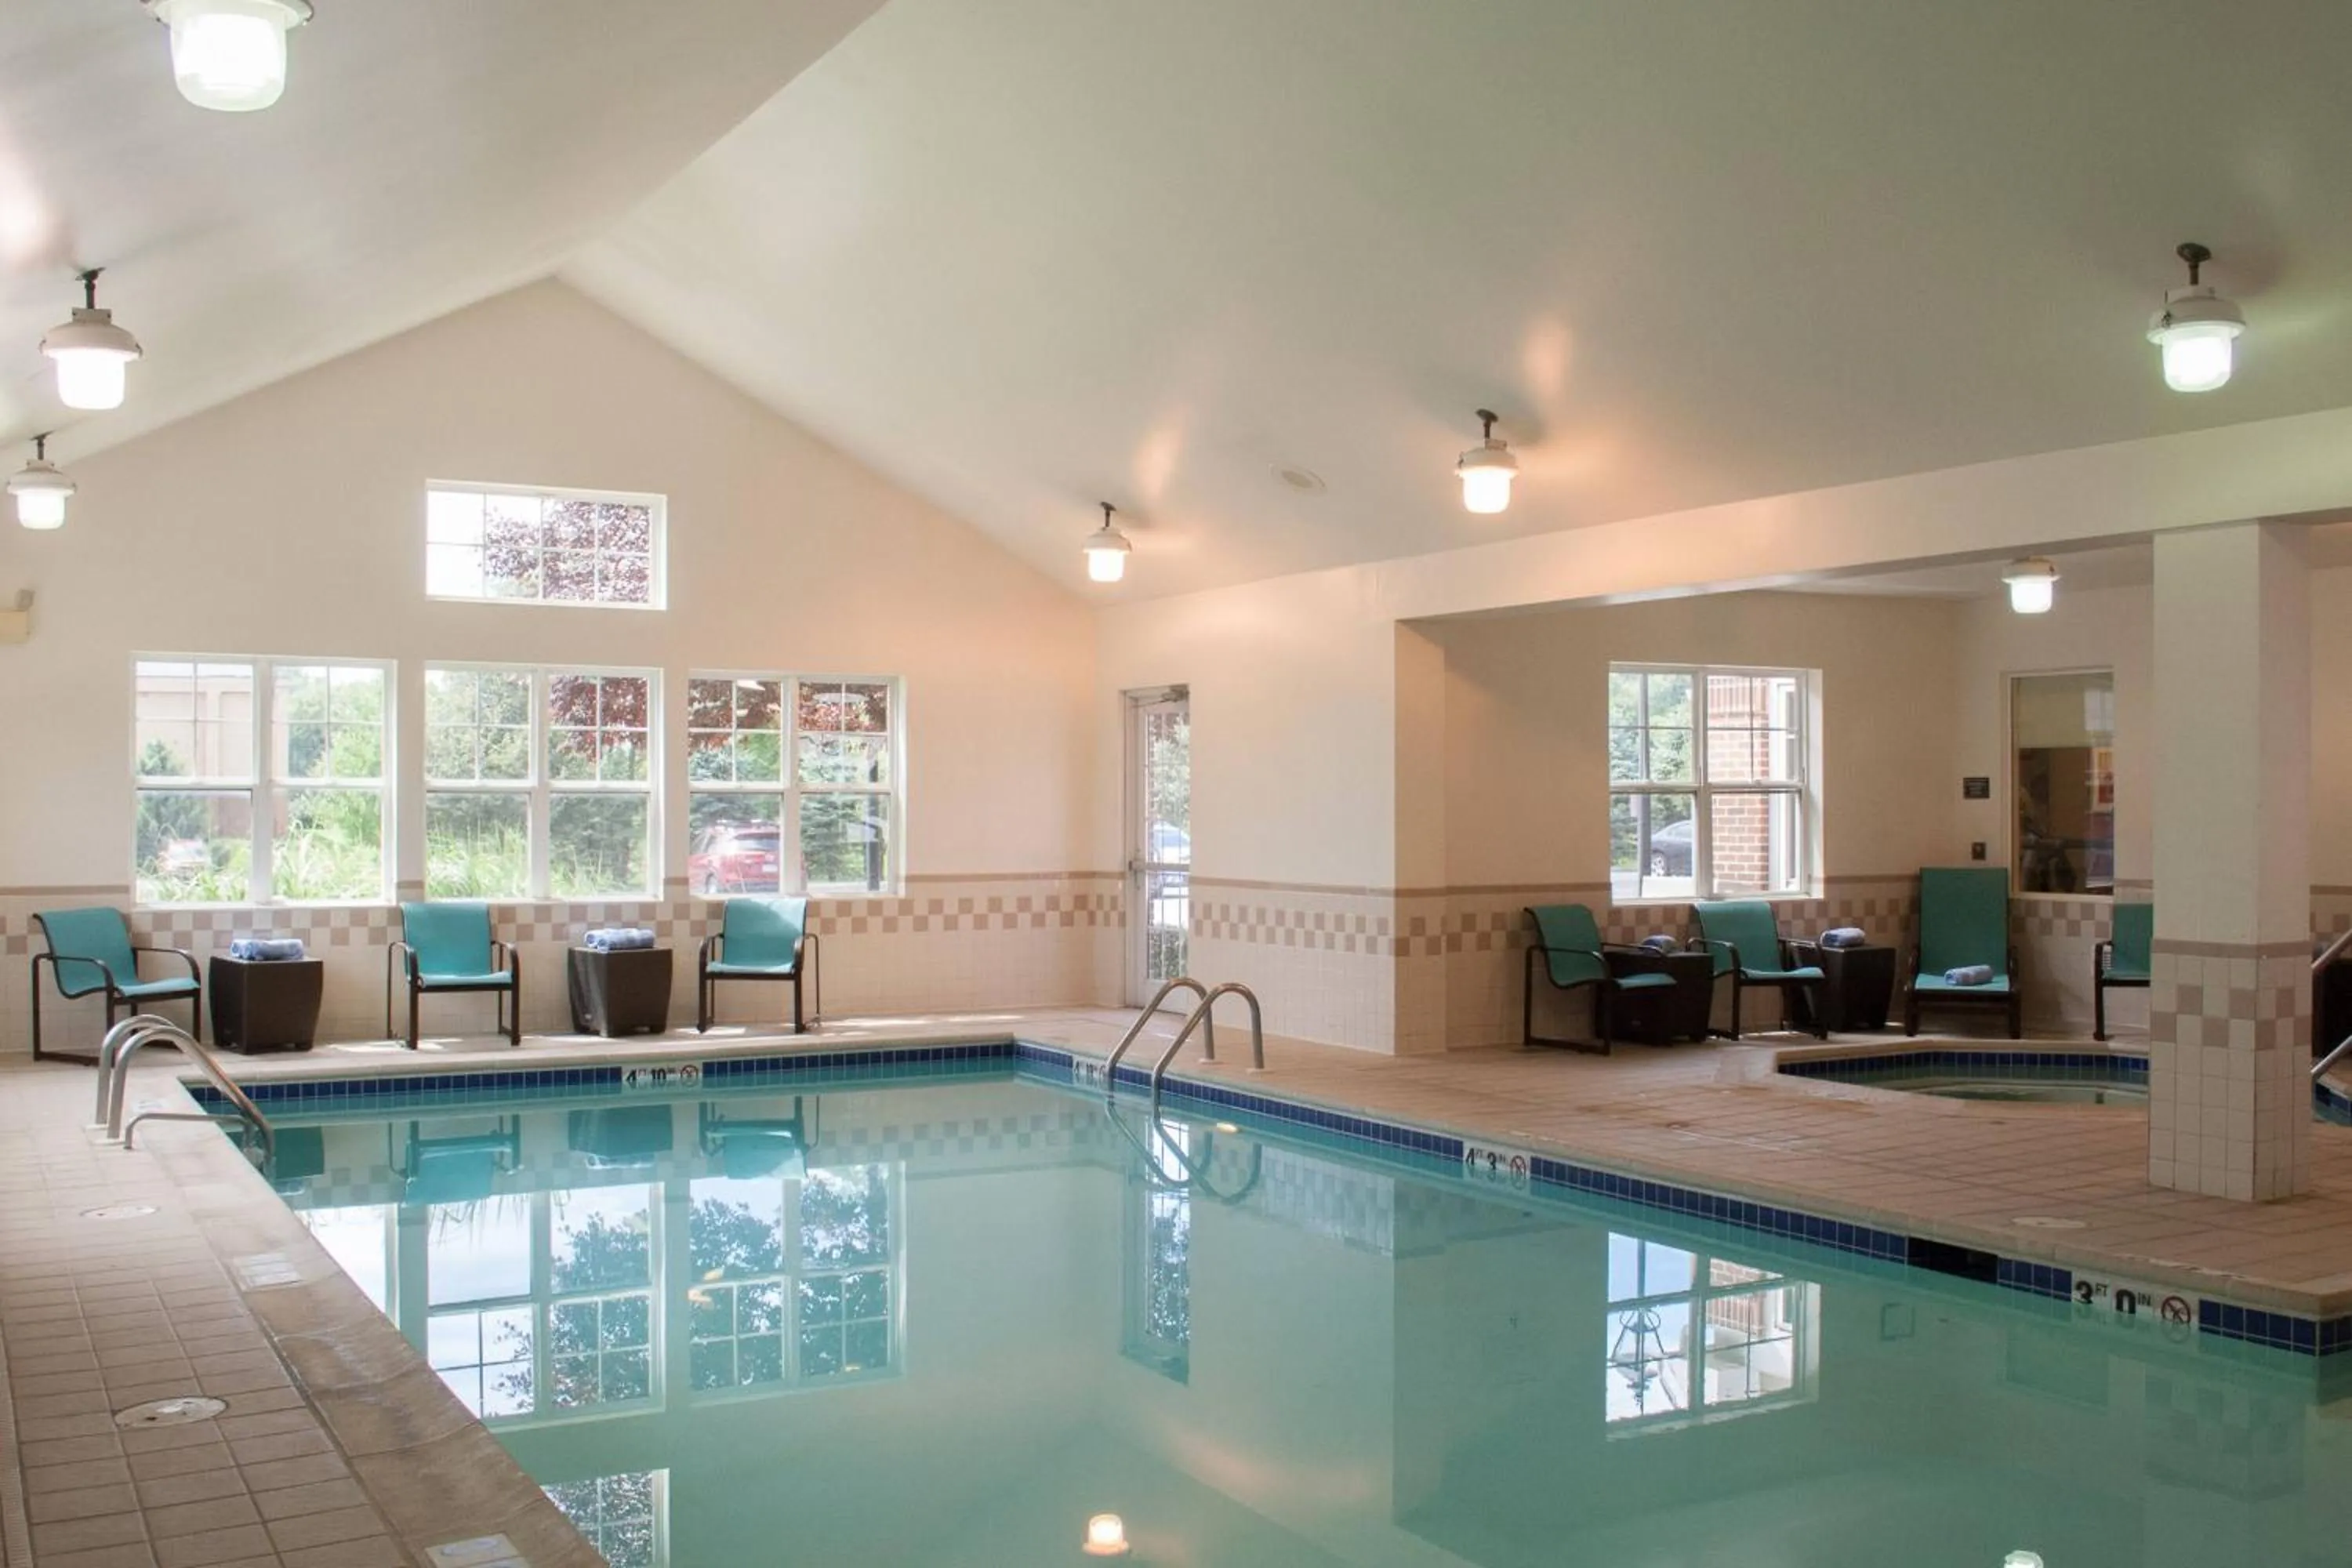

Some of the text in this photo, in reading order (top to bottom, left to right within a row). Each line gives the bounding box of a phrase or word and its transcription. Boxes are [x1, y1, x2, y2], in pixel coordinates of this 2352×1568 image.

[2074, 1280, 2093, 1305] 3
[2095, 1282, 2108, 1297] FT
[2137, 1291, 2151, 1306] IN
